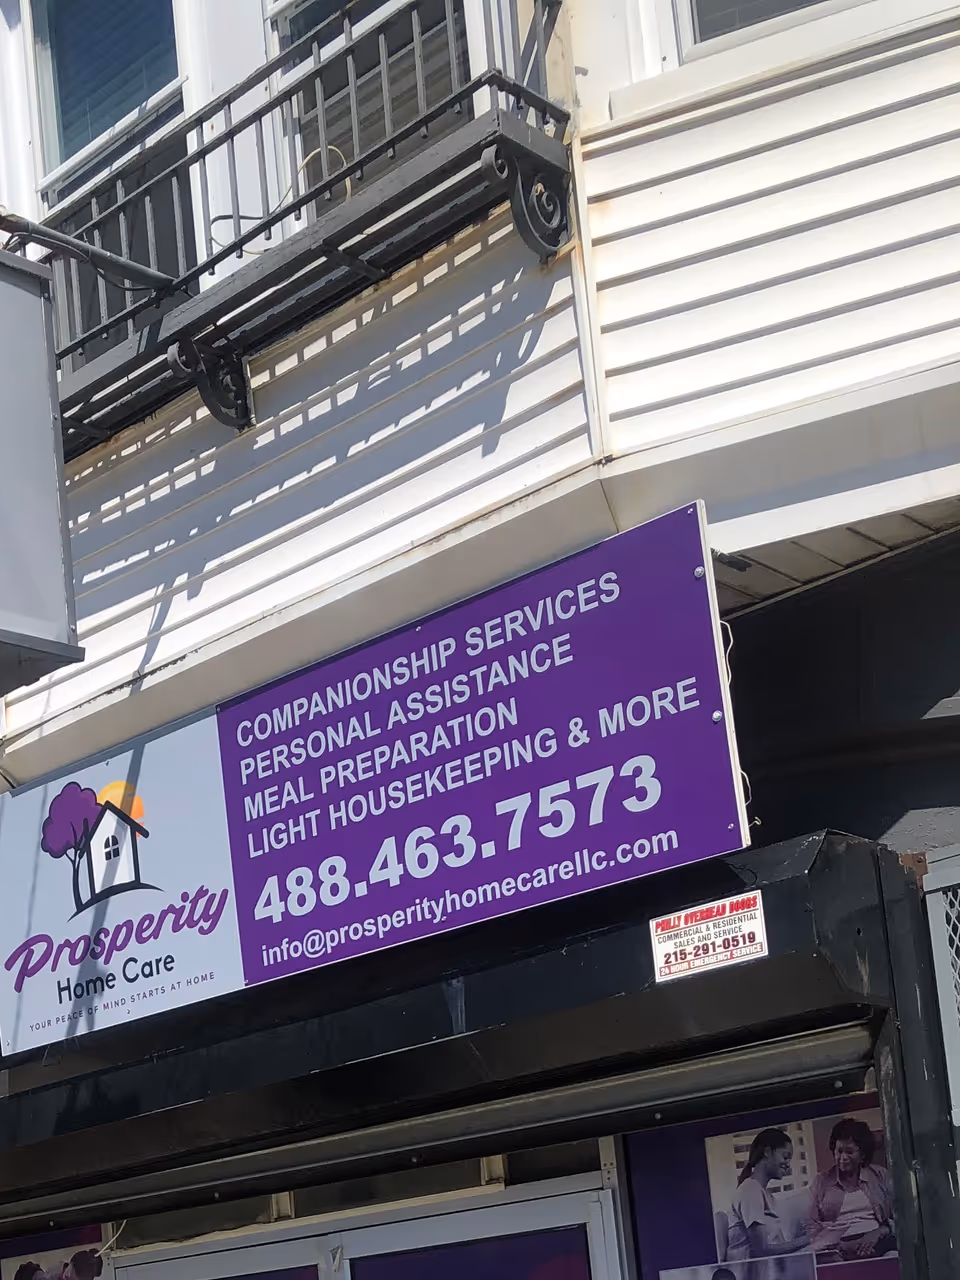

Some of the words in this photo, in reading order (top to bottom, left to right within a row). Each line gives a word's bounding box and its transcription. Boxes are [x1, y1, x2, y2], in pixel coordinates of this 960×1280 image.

[236, 637, 456, 747] COMPANIONSHIP
[465, 572, 620, 656] SERVICES
[240, 711, 381, 785] PERSONAL
[387, 633, 573, 730] ASSISTANCE
[244, 777, 314, 822] MEAL
[320, 697, 518, 794] PREPARATION
[248, 809, 321, 858] LIGHT
[329, 727, 557, 830] HOUSEKEEPING
[568, 717, 590, 748] &
[598, 676, 700, 738] MORE
[253, 754, 662, 924] 488.463.7573
[4, 884, 229, 993] Prosperity
[261, 828, 679, 967] info@prosperityhomecarellc.com
[655, 914, 682, 934] PHILLY
[684, 903, 727, 926] OVERHEAD
[729, 895, 758, 914] DOORS
[657, 925, 704, 945] COMMERCIAL
[705, 923, 711, 932] &
[712, 912, 758, 930] RESIDENTIAL
[673, 937, 696, 949] SALES
[697, 933, 712, 944] AND
[713, 925, 743, 939] SERVICE
[56, 972, 116, 1004] Home
[122, 954, 175, 983] Care
[660, 966, 670, 976] 24
[670, 961, 690, 973] HOUR
[690, 951, 731, 968] EMERGENCY
[732, 943, 762, 958] SERVICE
[663, 931, 756, 965] 215-291-0519
[30, 1019, 52, 1032] YOUR
[56, 1010, 84, 1025] PEACE
[87, 1005, 99, 1016] OF
[103, 998, 127, 1011] MIND
[130, 986, 166, 1003] STARTS
[170, 981, 182, 992] AT
[186, 971, 215, 986] HOME
